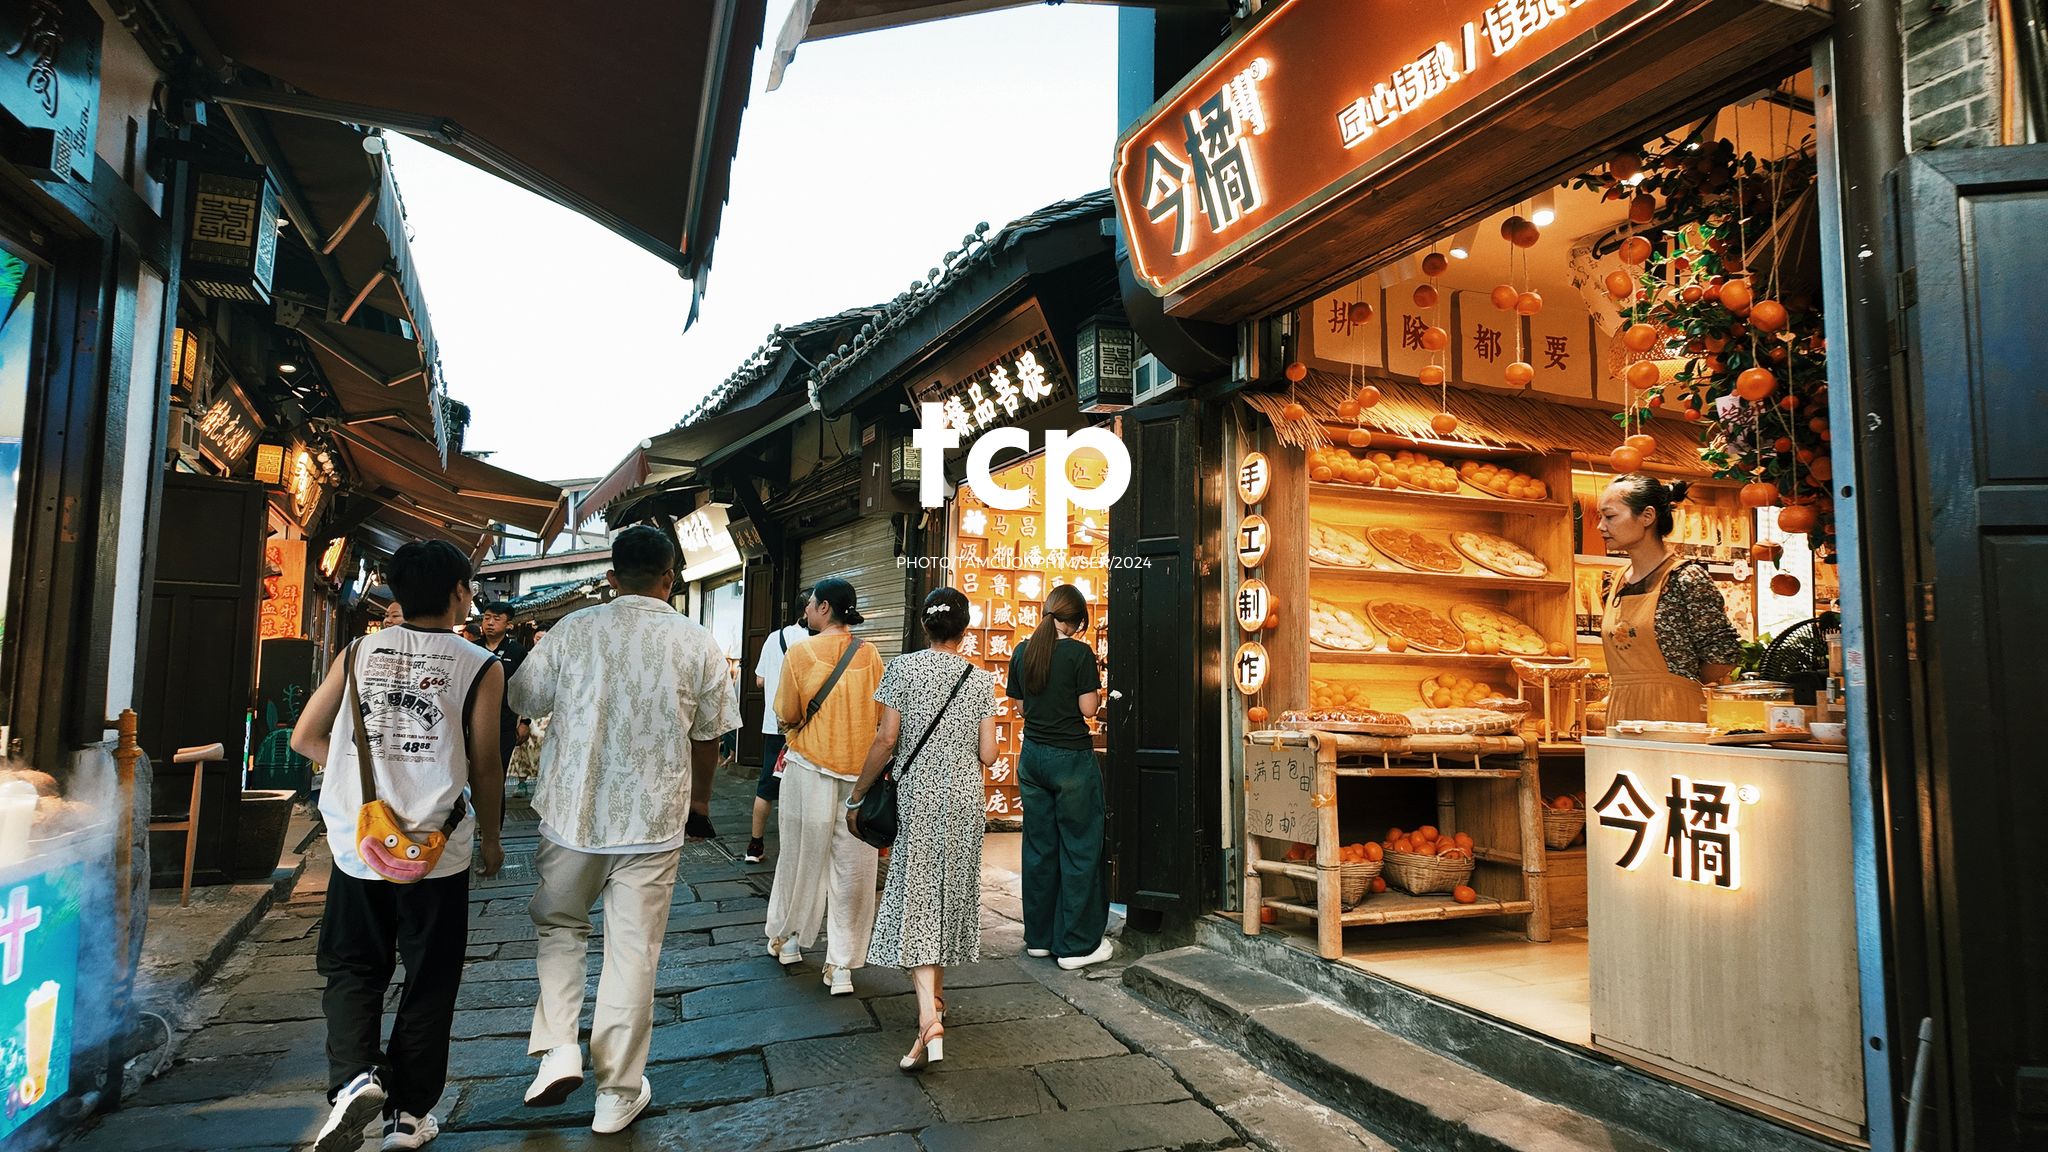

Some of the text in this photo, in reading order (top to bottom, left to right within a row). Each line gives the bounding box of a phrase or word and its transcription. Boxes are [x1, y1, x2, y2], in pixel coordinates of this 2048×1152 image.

[1336, 41, 1460, 149] 匠心传承
[1141, 84, 1262, 257] 今橘
[990, 515, 1010, 536] 马
[1020, 515, 1037, 538] 昌
[962, 573, 981, 594] 吕
[989, 573, 1011, 598] 鲁
[1237, 461, 1261, 684] 手工制作
[1017, 605, 1039, 628] 谢
[987, 757, 1012, 784] 彭
[1593, 770, 1740, 891] 今橘
